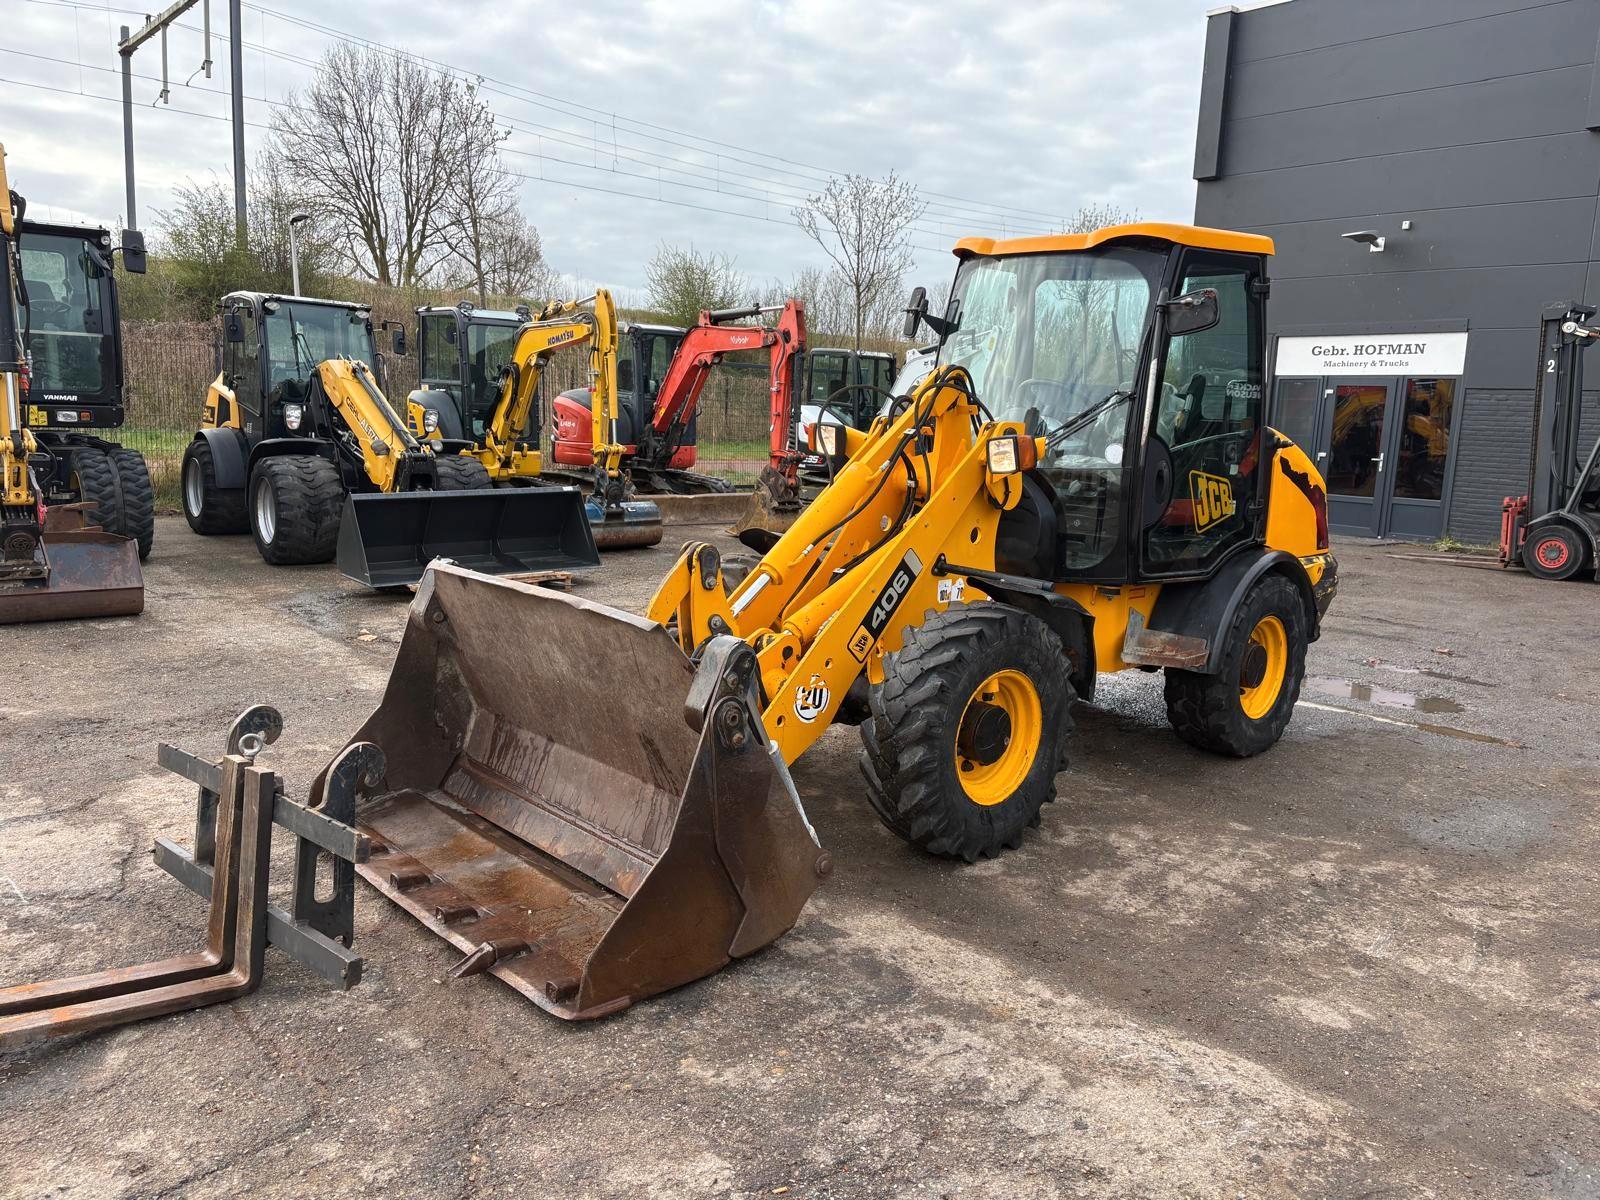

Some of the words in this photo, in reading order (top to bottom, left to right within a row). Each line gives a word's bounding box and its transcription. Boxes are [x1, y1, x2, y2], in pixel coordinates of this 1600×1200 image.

[547, 330, 574, 346] KOMATSU
[1311, 345, 1349, 356] Gebr.
[1353, 343, 1427, 356] HOFMAN
[1323, 360, 1368, 368] Machinery
[1547, 359, 1555, 373] 2
[43, 394, 78, 402] YANMAR
[1196, 477, 1233, 526] JCB
[871, 569, 910, 630] 406
[855, 634, 869, 653] JCB
